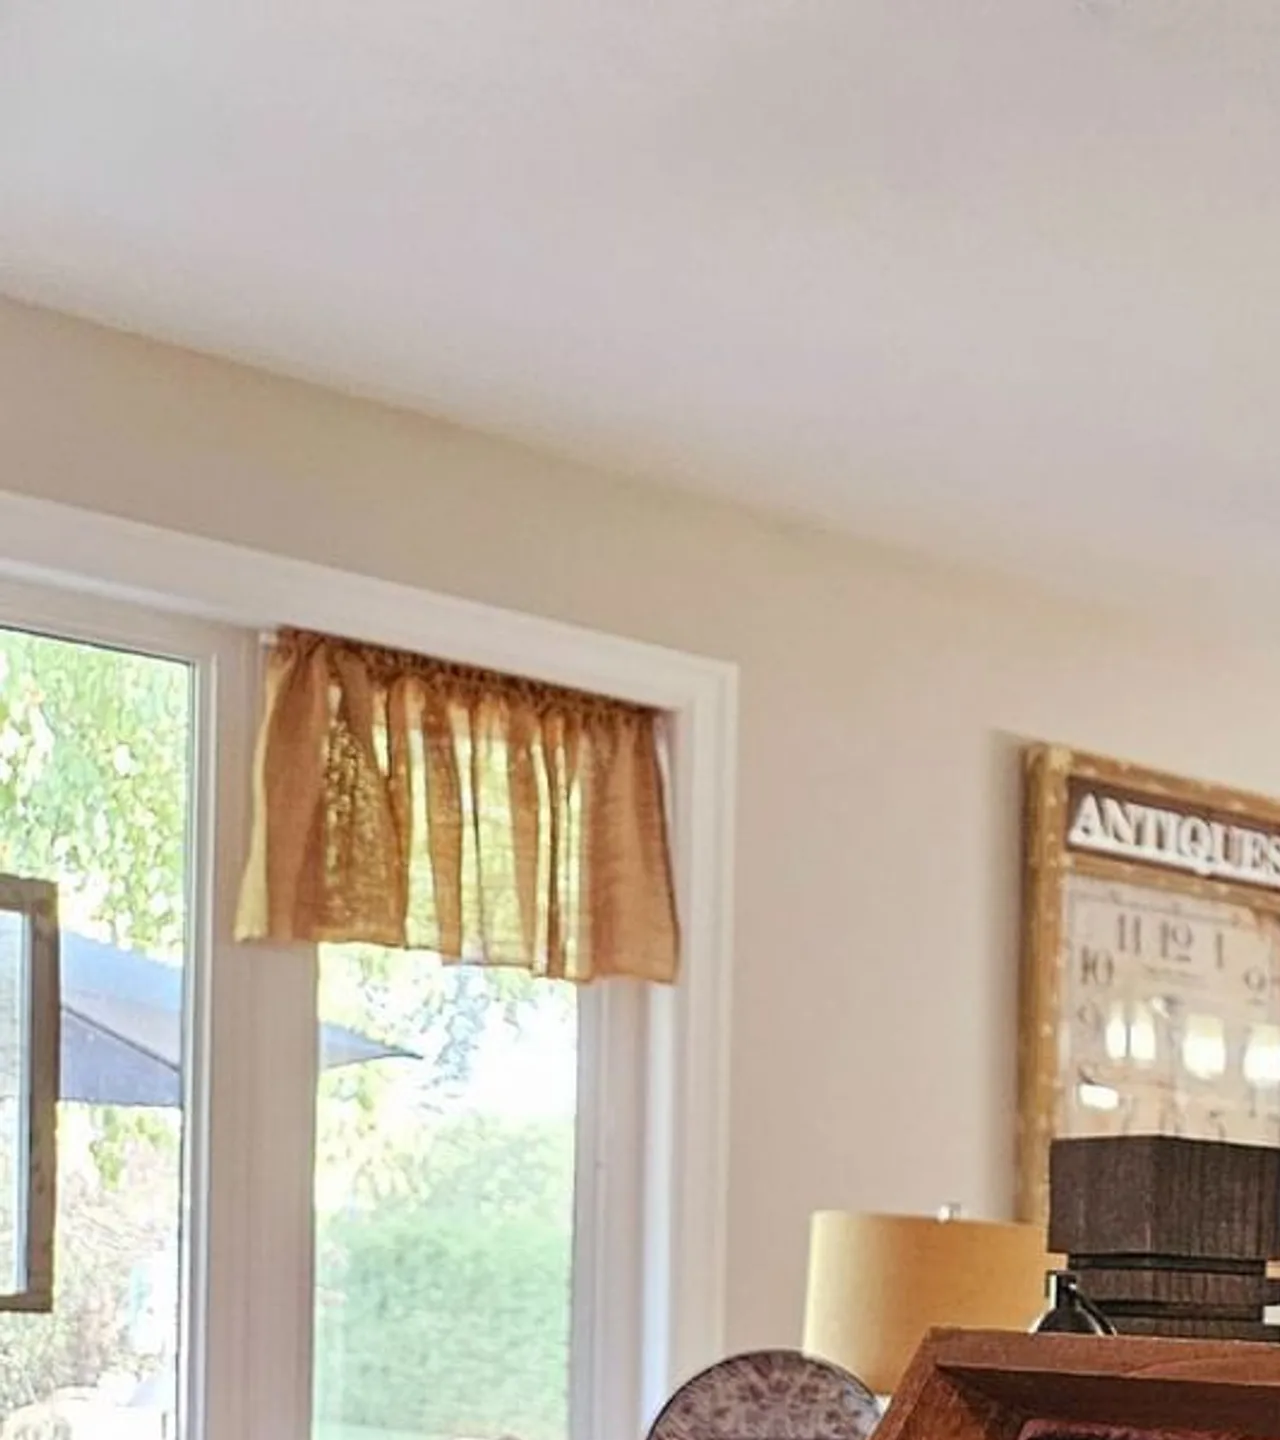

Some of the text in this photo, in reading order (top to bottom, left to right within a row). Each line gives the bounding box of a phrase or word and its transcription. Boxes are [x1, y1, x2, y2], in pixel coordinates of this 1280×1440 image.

[1116, 912, 1142, 956] 11
[1158, 920, 1193, 963] 12
[1080, 944, 1115, 986] 10
